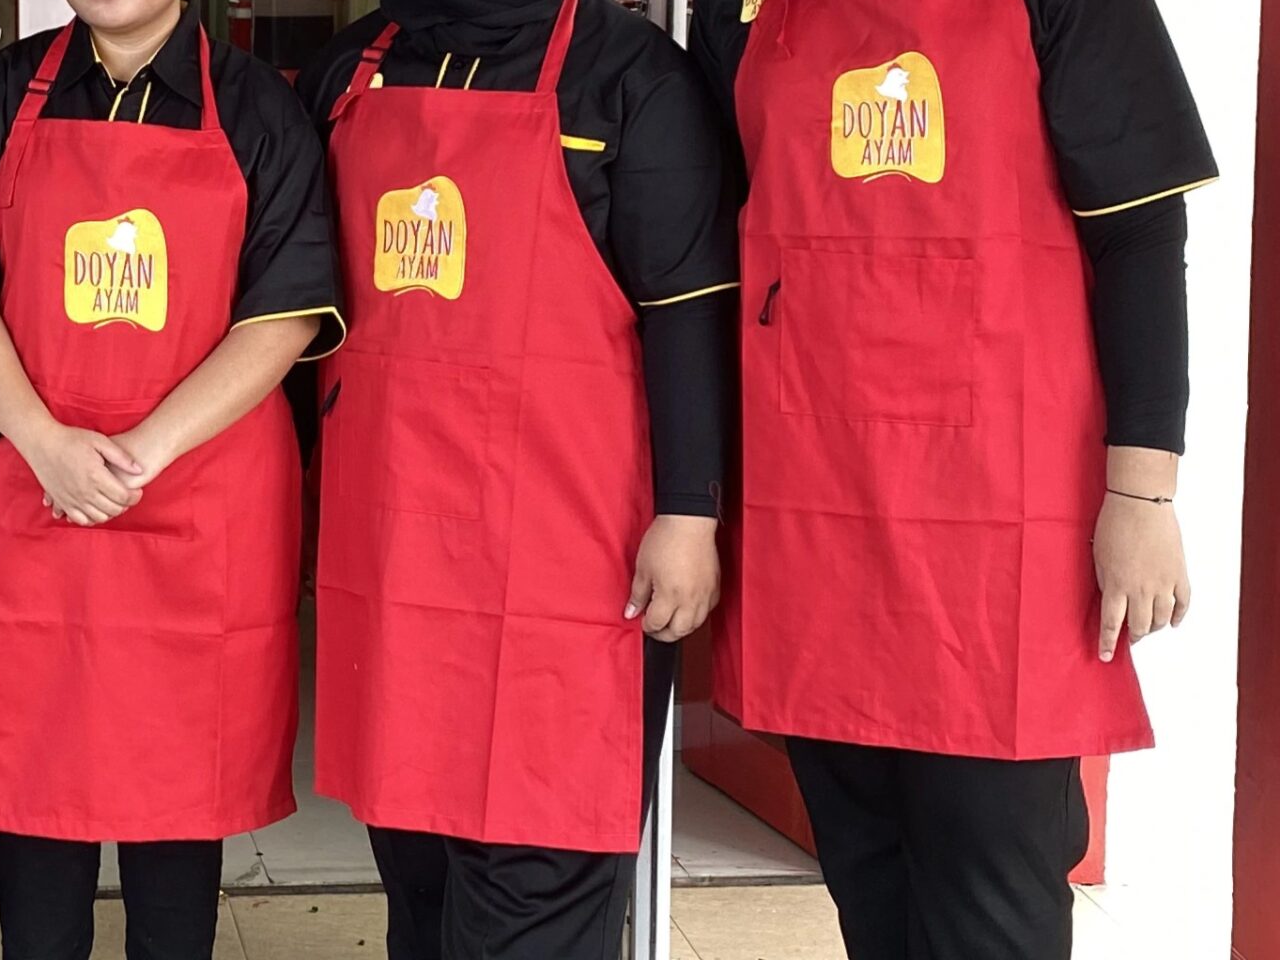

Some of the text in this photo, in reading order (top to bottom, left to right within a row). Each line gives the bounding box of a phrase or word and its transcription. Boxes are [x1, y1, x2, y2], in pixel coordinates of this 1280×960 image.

[842, 99, 928, 139] DOYAN
[861, 139, 913, 166] AYAM
[383, 219, 454, 256] DOYAN
[74, 251, 153, 289] DOYAN
[396, 255, 439, 280] AYAM
[93, 288, 139, 314] AYAM
